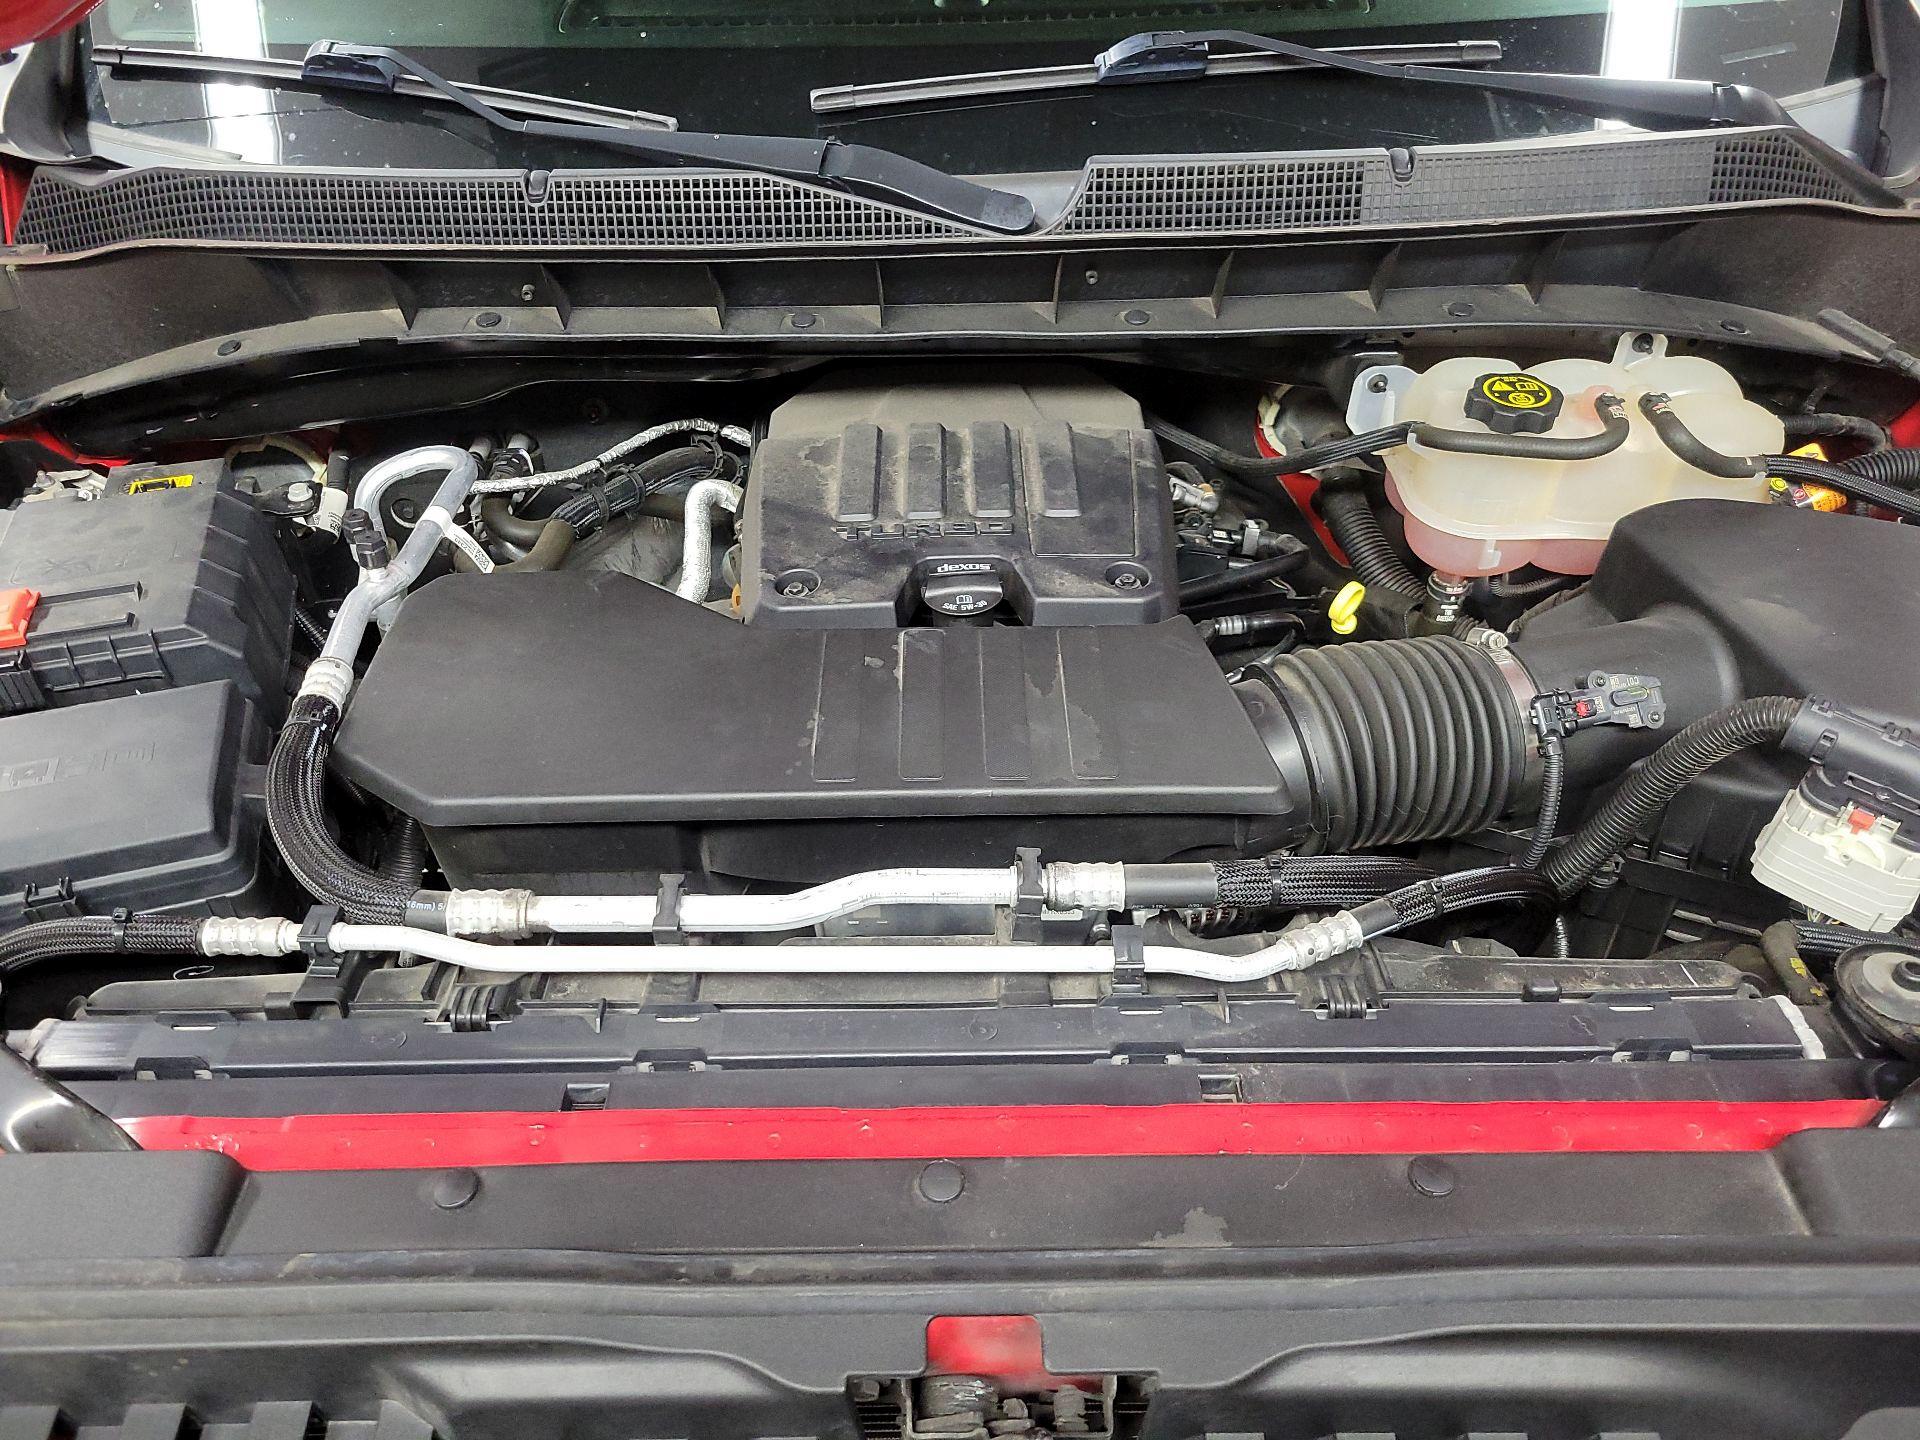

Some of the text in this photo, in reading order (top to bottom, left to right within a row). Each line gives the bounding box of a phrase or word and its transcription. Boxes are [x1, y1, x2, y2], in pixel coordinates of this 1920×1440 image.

[834, 521, 1013, 541] TURBO
[937, 563, 991, 572] dexos
[942, 600, 987, 611] SAE 5W-30
